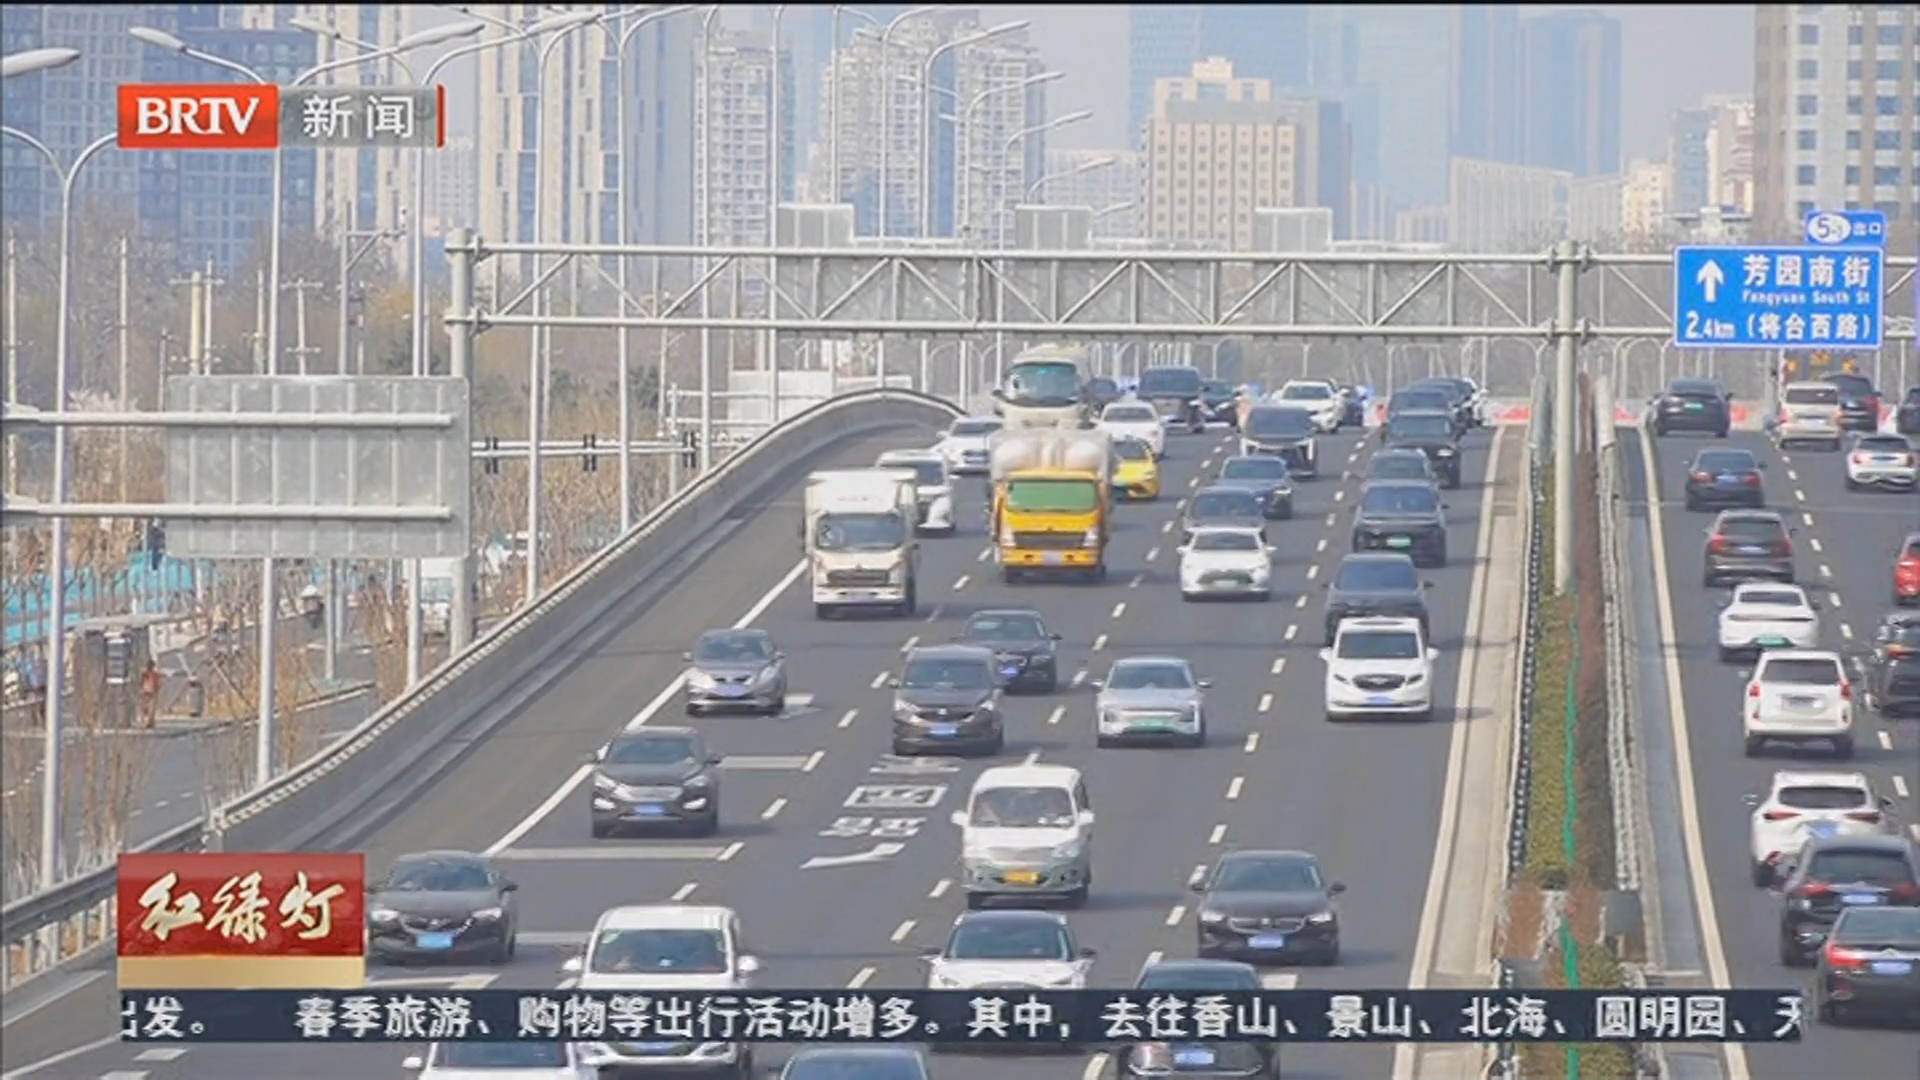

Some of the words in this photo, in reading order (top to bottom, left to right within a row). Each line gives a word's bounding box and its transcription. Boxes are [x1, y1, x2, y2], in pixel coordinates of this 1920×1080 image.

[1743, 254, 1871, 288] 芳园南街
[1685, 310, 1736, 339] 2.4km
